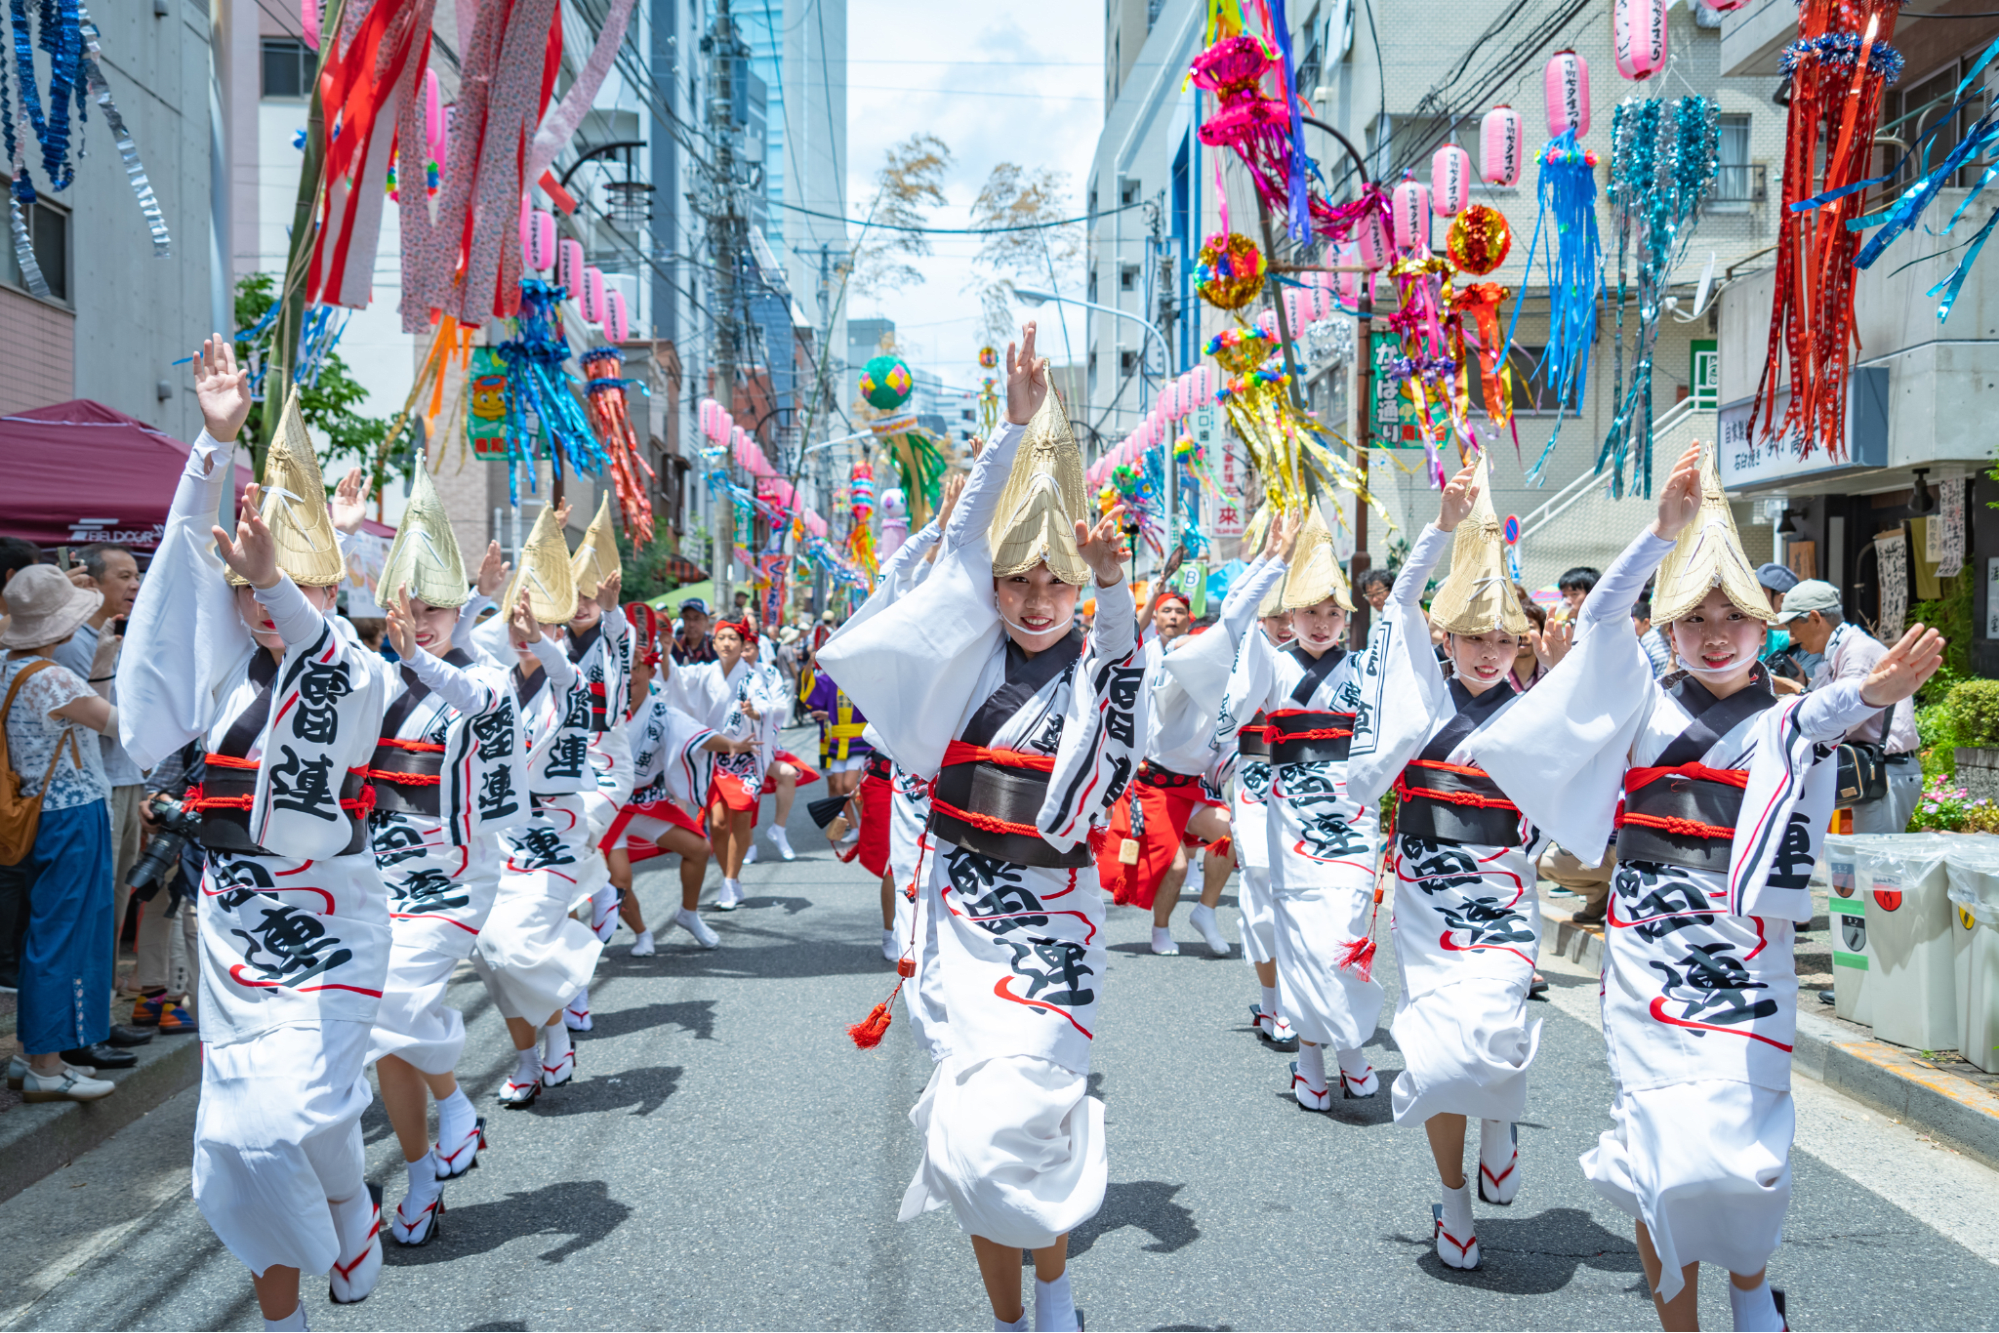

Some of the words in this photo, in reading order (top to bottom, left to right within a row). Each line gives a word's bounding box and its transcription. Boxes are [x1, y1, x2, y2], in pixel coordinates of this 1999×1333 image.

[1564, 60, 1579, 128] 下町七夕まつり
[1505, 118, 1517, 182] 下町七夕まつり
[1450, 153, 1461, 213] 下町七夕まつり
[1186, 571, 1196, 584] B
